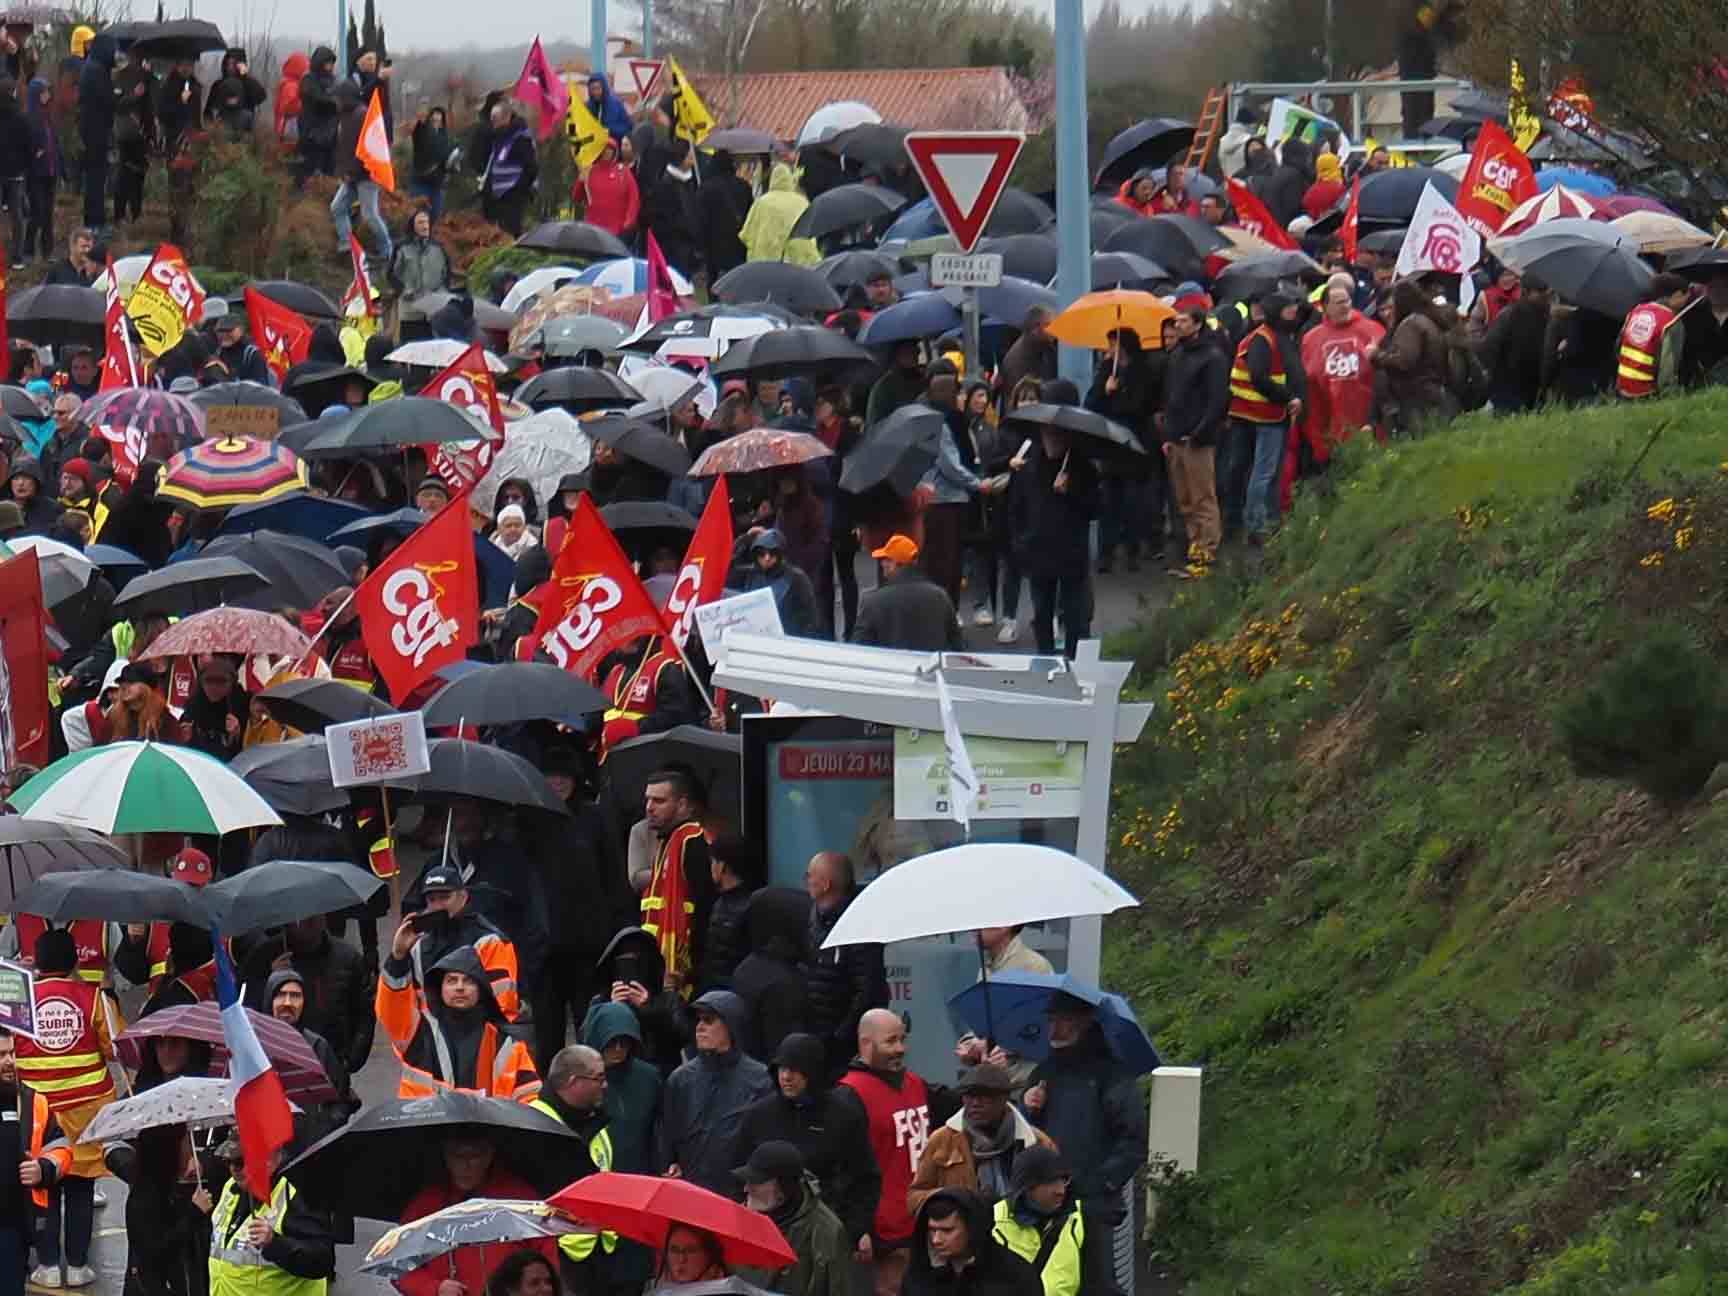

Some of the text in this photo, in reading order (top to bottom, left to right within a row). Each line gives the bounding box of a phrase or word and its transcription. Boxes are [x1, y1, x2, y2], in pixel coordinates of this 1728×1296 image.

[1325, 347, 1360, 379] cgt
[382, 567, 460, 669] cgt
[38, 1018, 74, 1031] SUBIR
